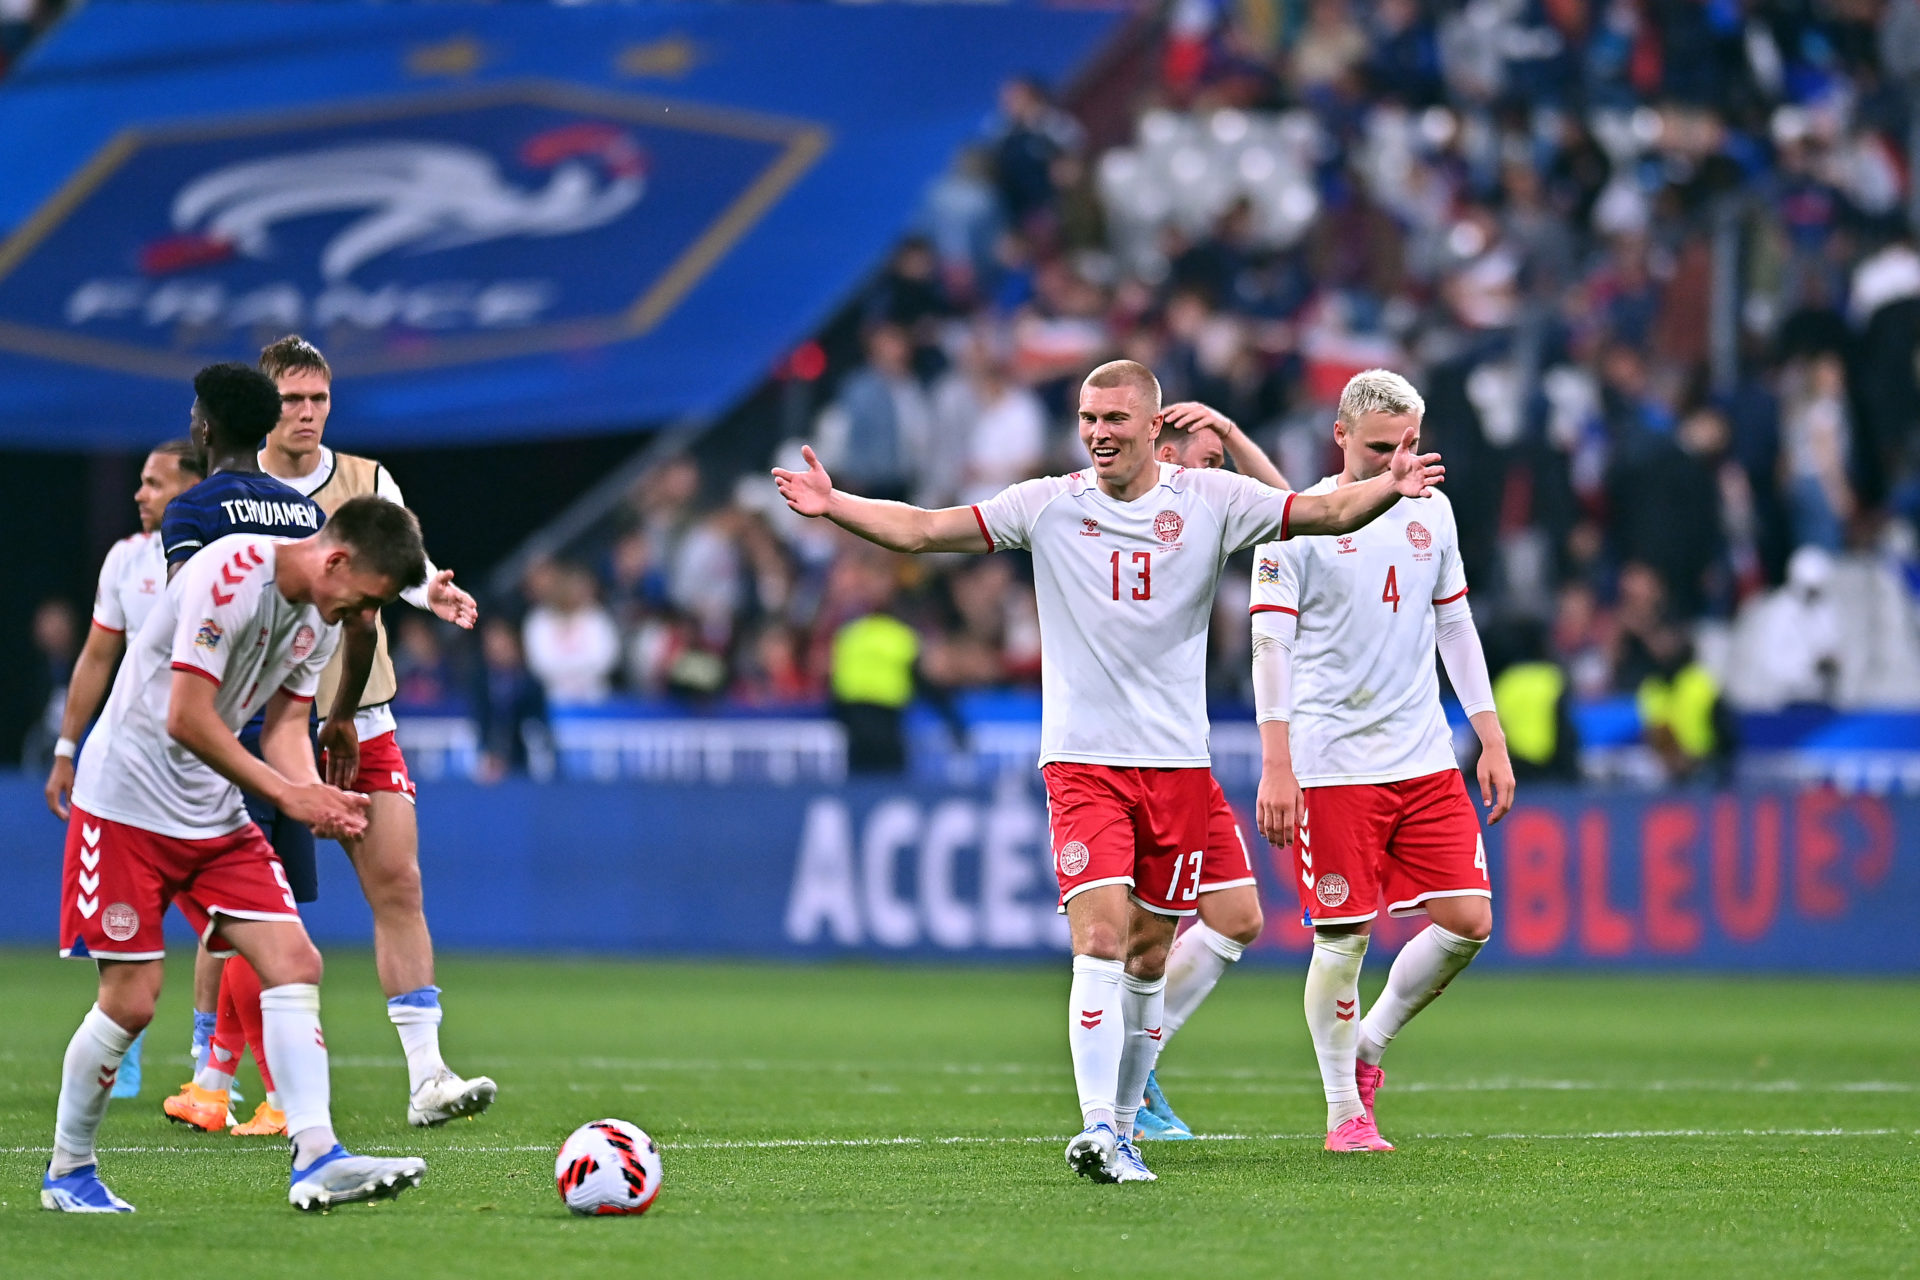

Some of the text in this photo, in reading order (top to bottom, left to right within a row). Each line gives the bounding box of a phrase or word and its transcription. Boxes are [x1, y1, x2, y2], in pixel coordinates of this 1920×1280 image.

[66, 279, 556, 329] FRANCE
[1159, 520, 1178, 532] DBU
[1110, 551, 1151, 601] 13
[1382, 565, 1400, 613] 4
[1166, 850, 1203, 900] 13
[1474, 833, 1487, 880] 4
[1323, 885, 1342, 894] DBU
